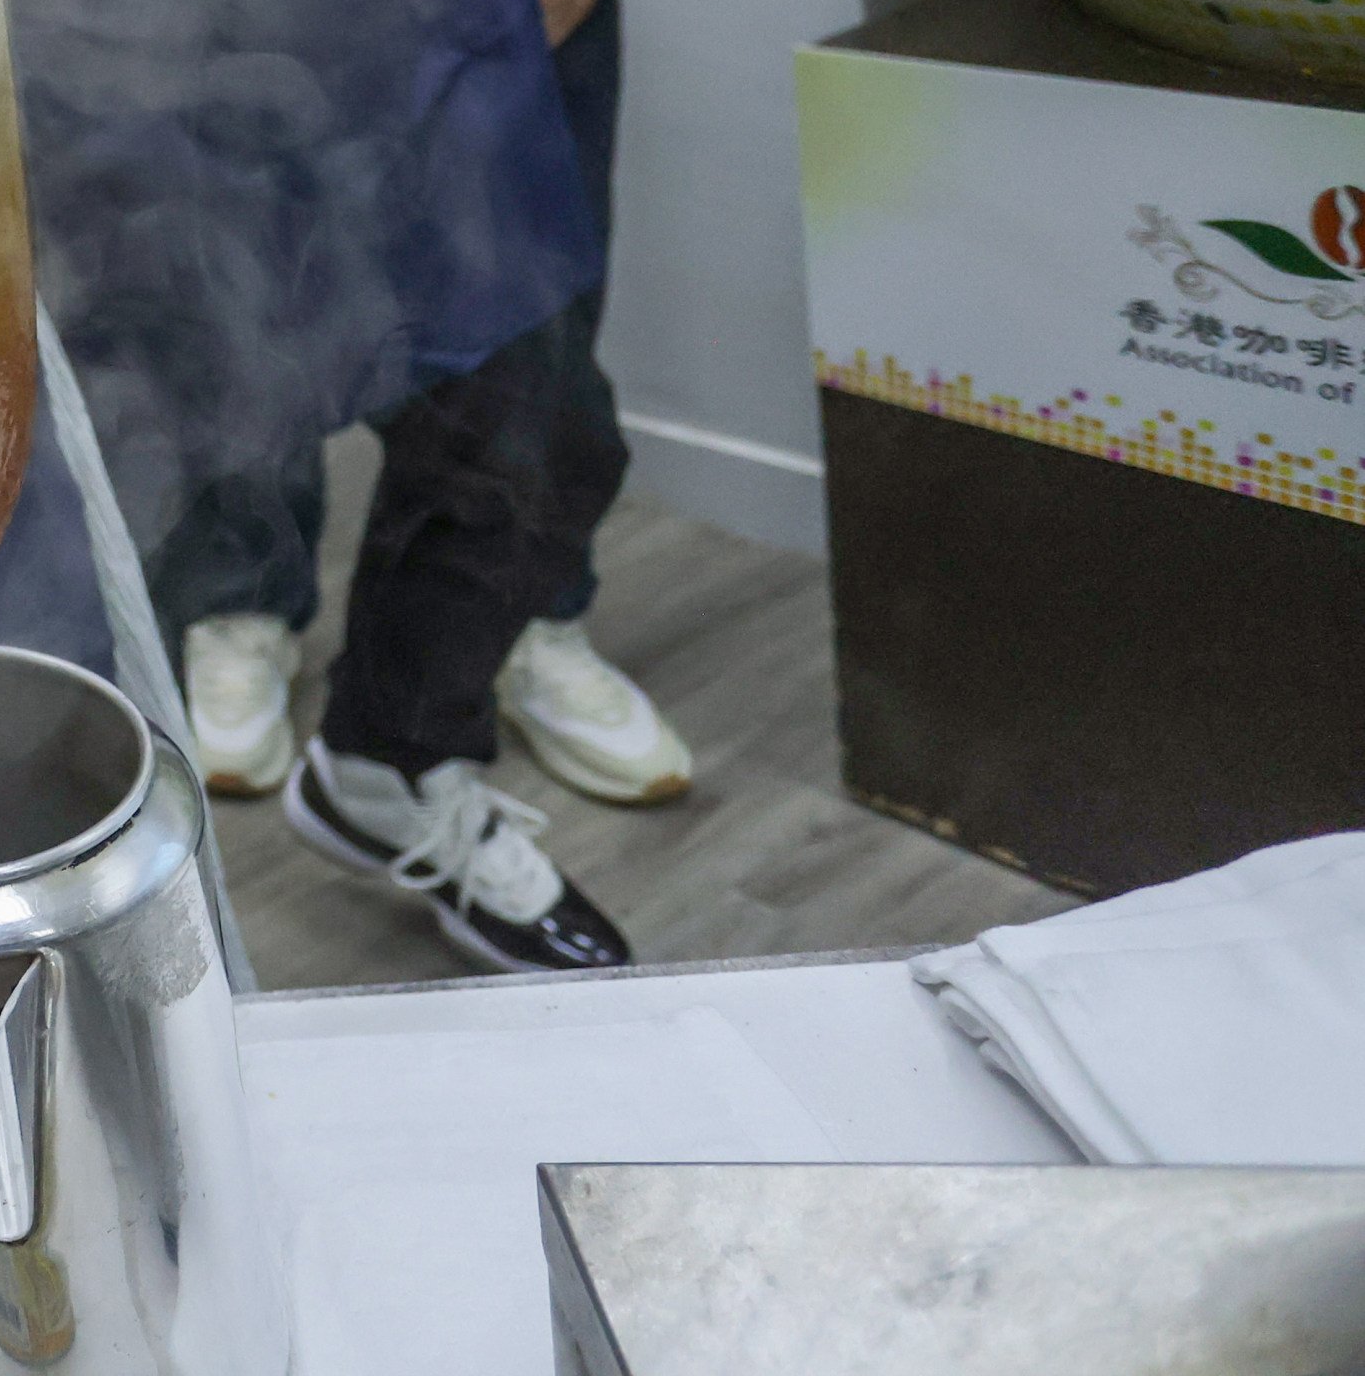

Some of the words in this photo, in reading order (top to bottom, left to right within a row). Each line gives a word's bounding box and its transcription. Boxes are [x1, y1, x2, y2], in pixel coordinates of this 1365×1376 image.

[1117, 298, 1365, 376] 香港咖啡
[1318, 381, 1356, 405] of
